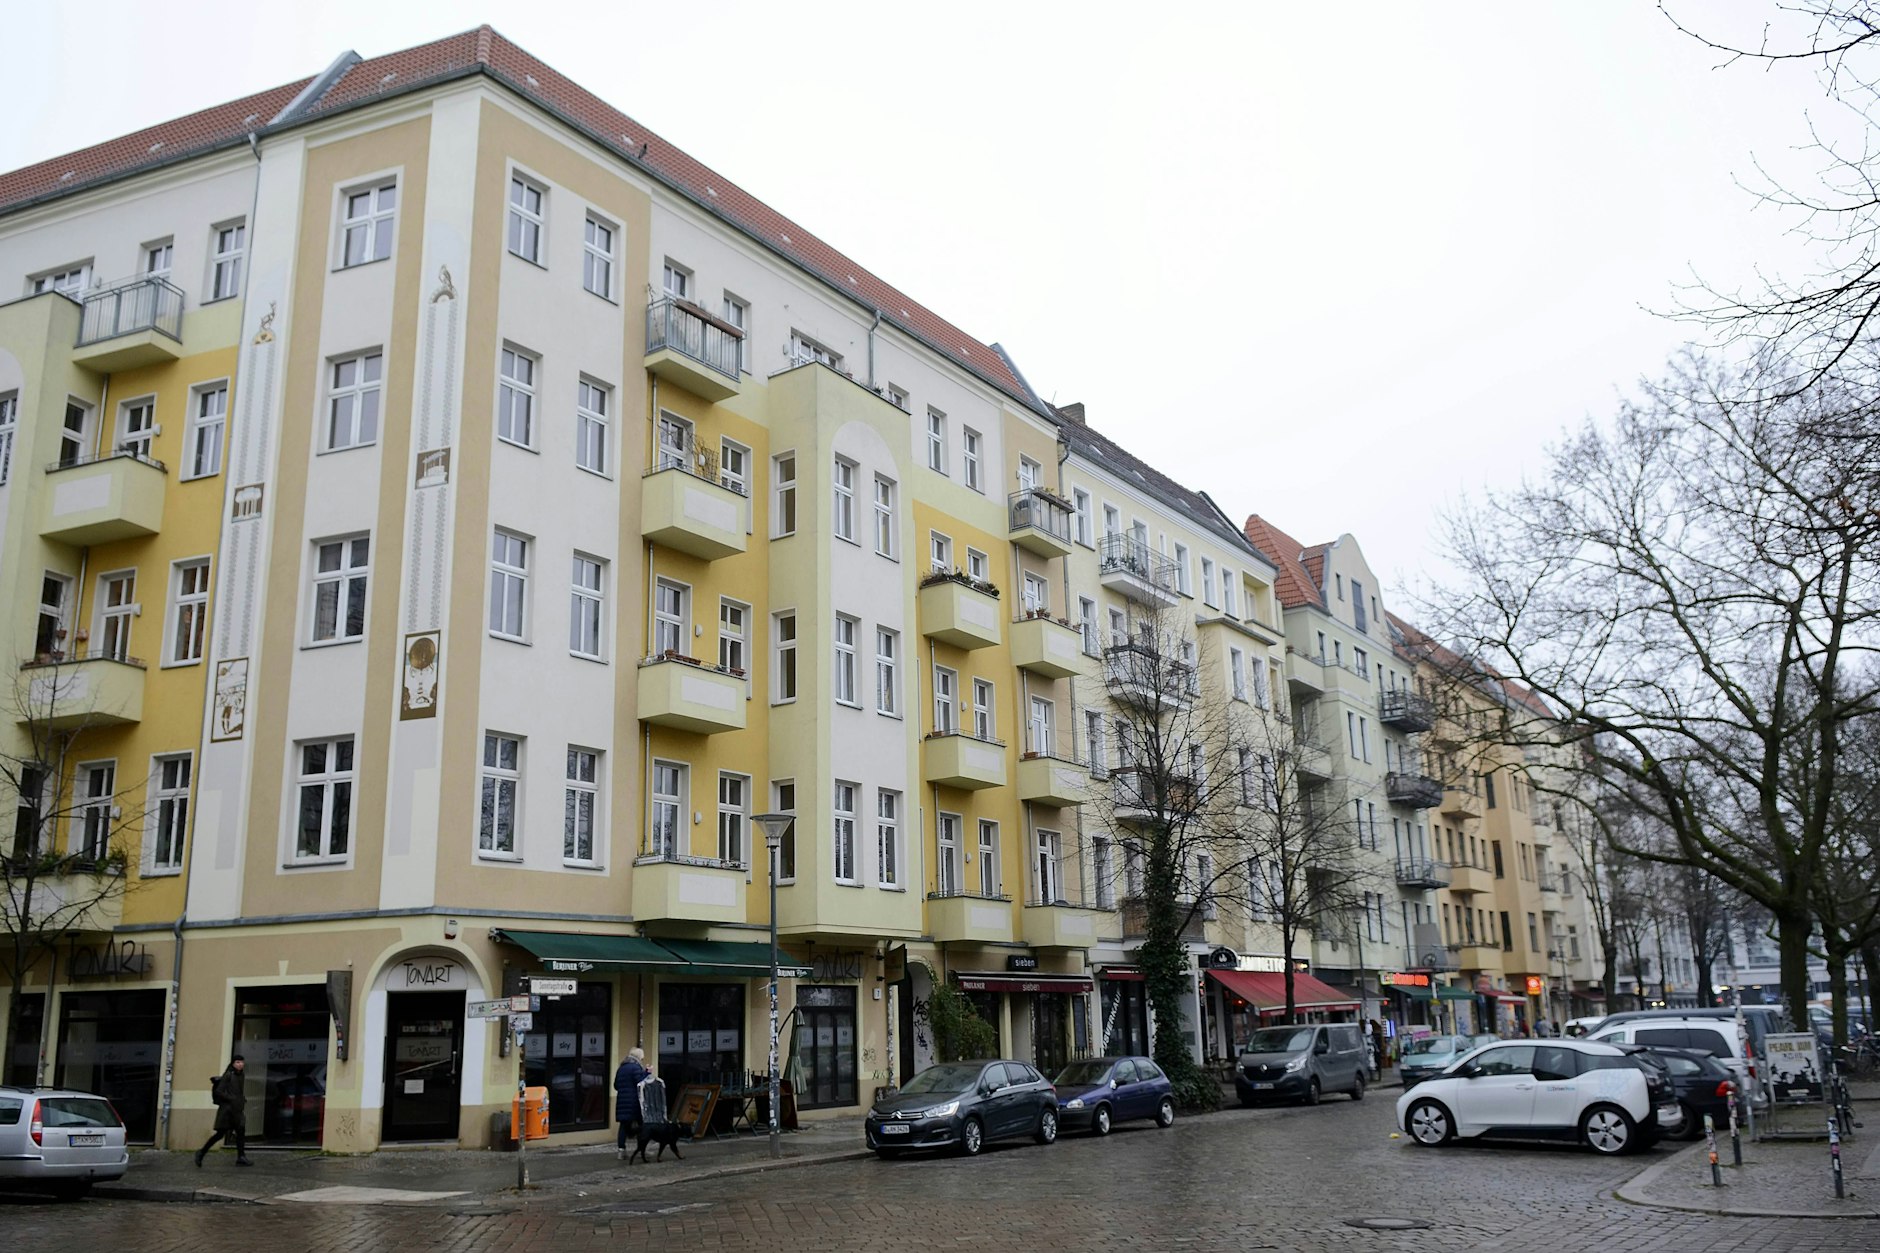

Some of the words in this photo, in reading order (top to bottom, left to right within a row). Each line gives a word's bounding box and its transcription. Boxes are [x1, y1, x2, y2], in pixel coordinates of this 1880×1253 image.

[552, 961, 578, 971] BERLINER
[1015, 958, 1035, 967] sieben
[403, 963, 454, 987] TONART
[1022, 981, 1040, 992] sieben
[560, 1041, 571, 1050] sky
